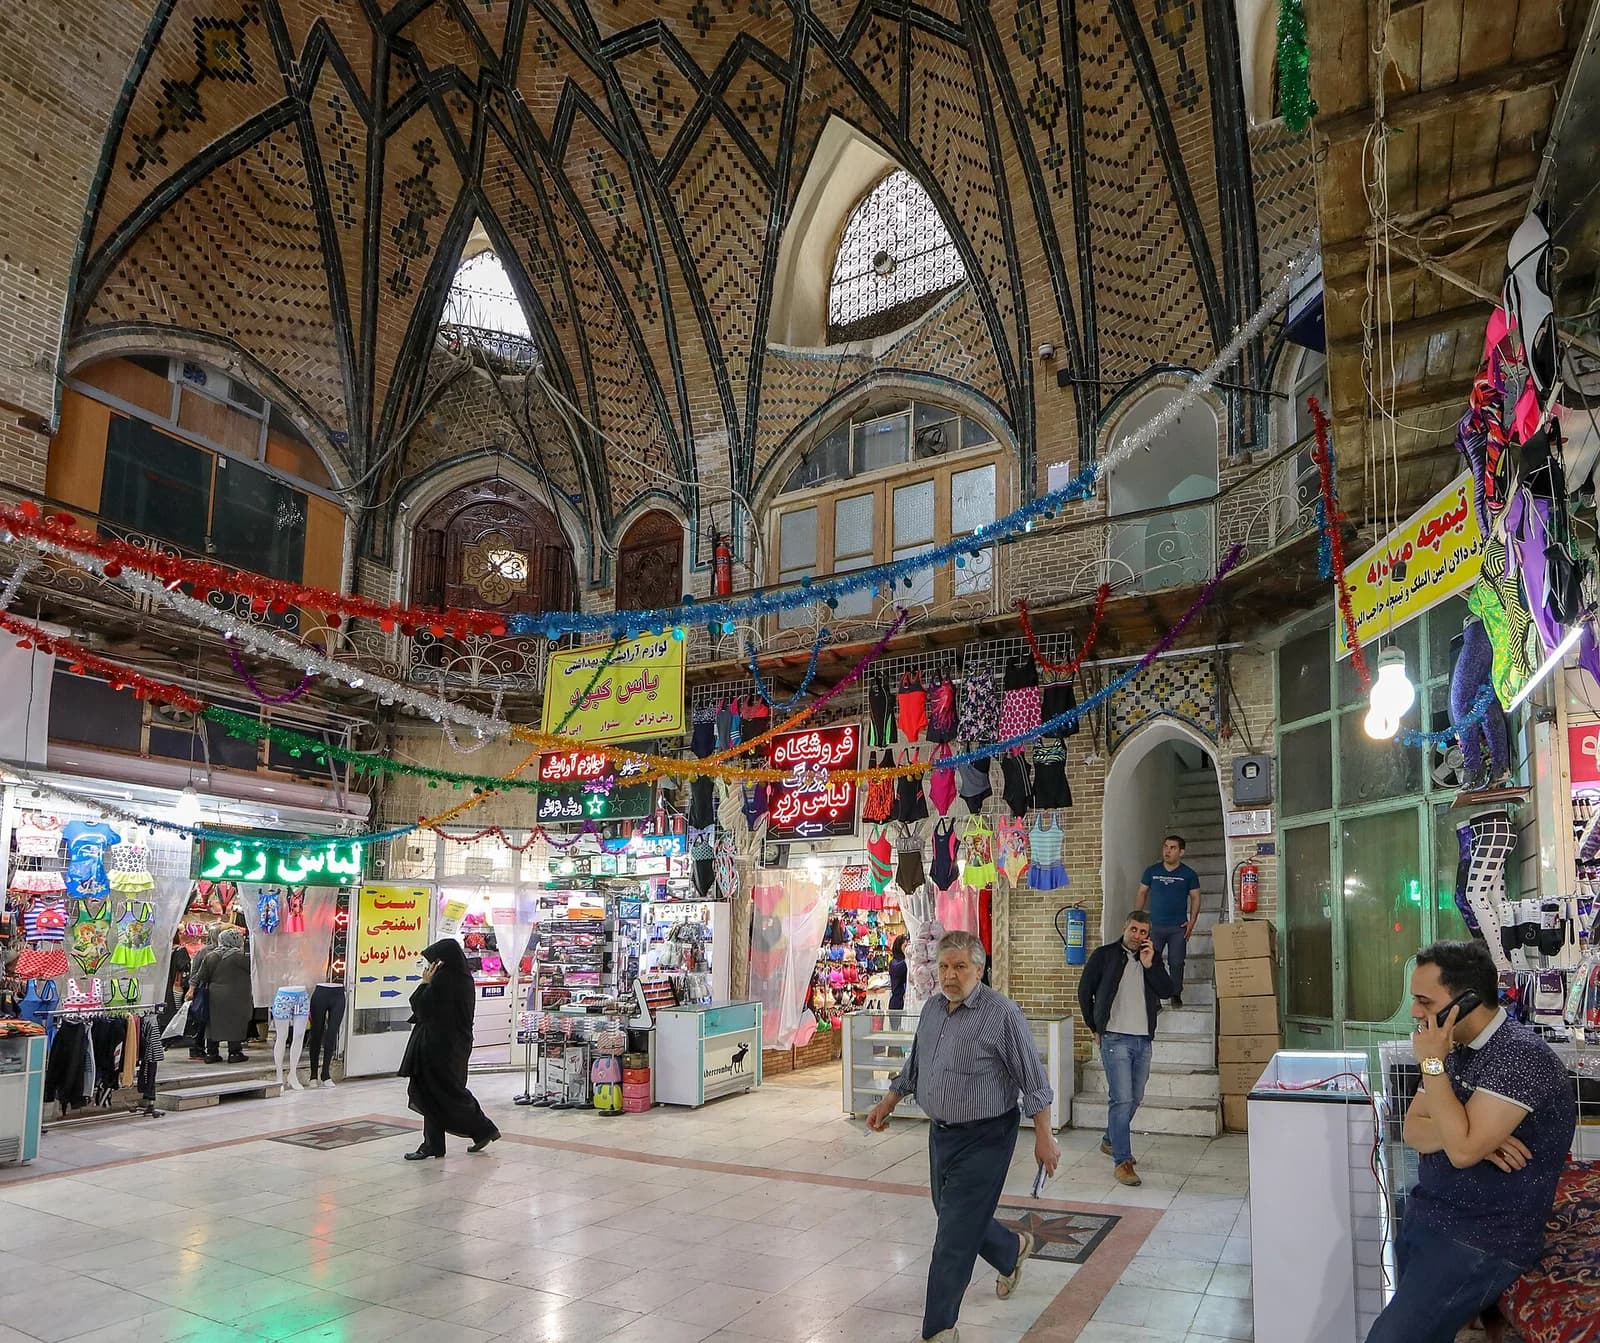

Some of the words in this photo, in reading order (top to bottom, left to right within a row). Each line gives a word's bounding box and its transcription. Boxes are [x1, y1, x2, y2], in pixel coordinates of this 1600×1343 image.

[1416, 486, 1469, 552] تیمچه
[1432, 557, 1449, 584] امین
[1449, 546, 1468, 573] دالان
[1411, 568, 1432, 594] الملک
[1386, 586, 1404, 611] تیمچه
[642, 640, 668, 658] لوازم
[569, 678, 613, 710] کبود
[616, 668, 659, 703] یاس
[600, 720, 620, 732] سشوار
[634, 713, 655, 726] تراش
[656, 711, 673, 723] ریش
[775, 727, 853, 764] فروشگاه
[542, 753, 578, 778] آرایشی
[577, 753, 605, 775] لوازم
[539, 798, 562, 817] تراش
[562, 797, 583, 816] ریش
[772, 792, 801, 822] زیر
[802, 781, 851, 817] لباس
[201, 841, 267, 880] زیر
[277, 842, 363, 884] لباس
[374, 895, 416, 909] ست
[367, 916, 421, 935] اسفنجی
[360, 946, 389, 964] تومان
